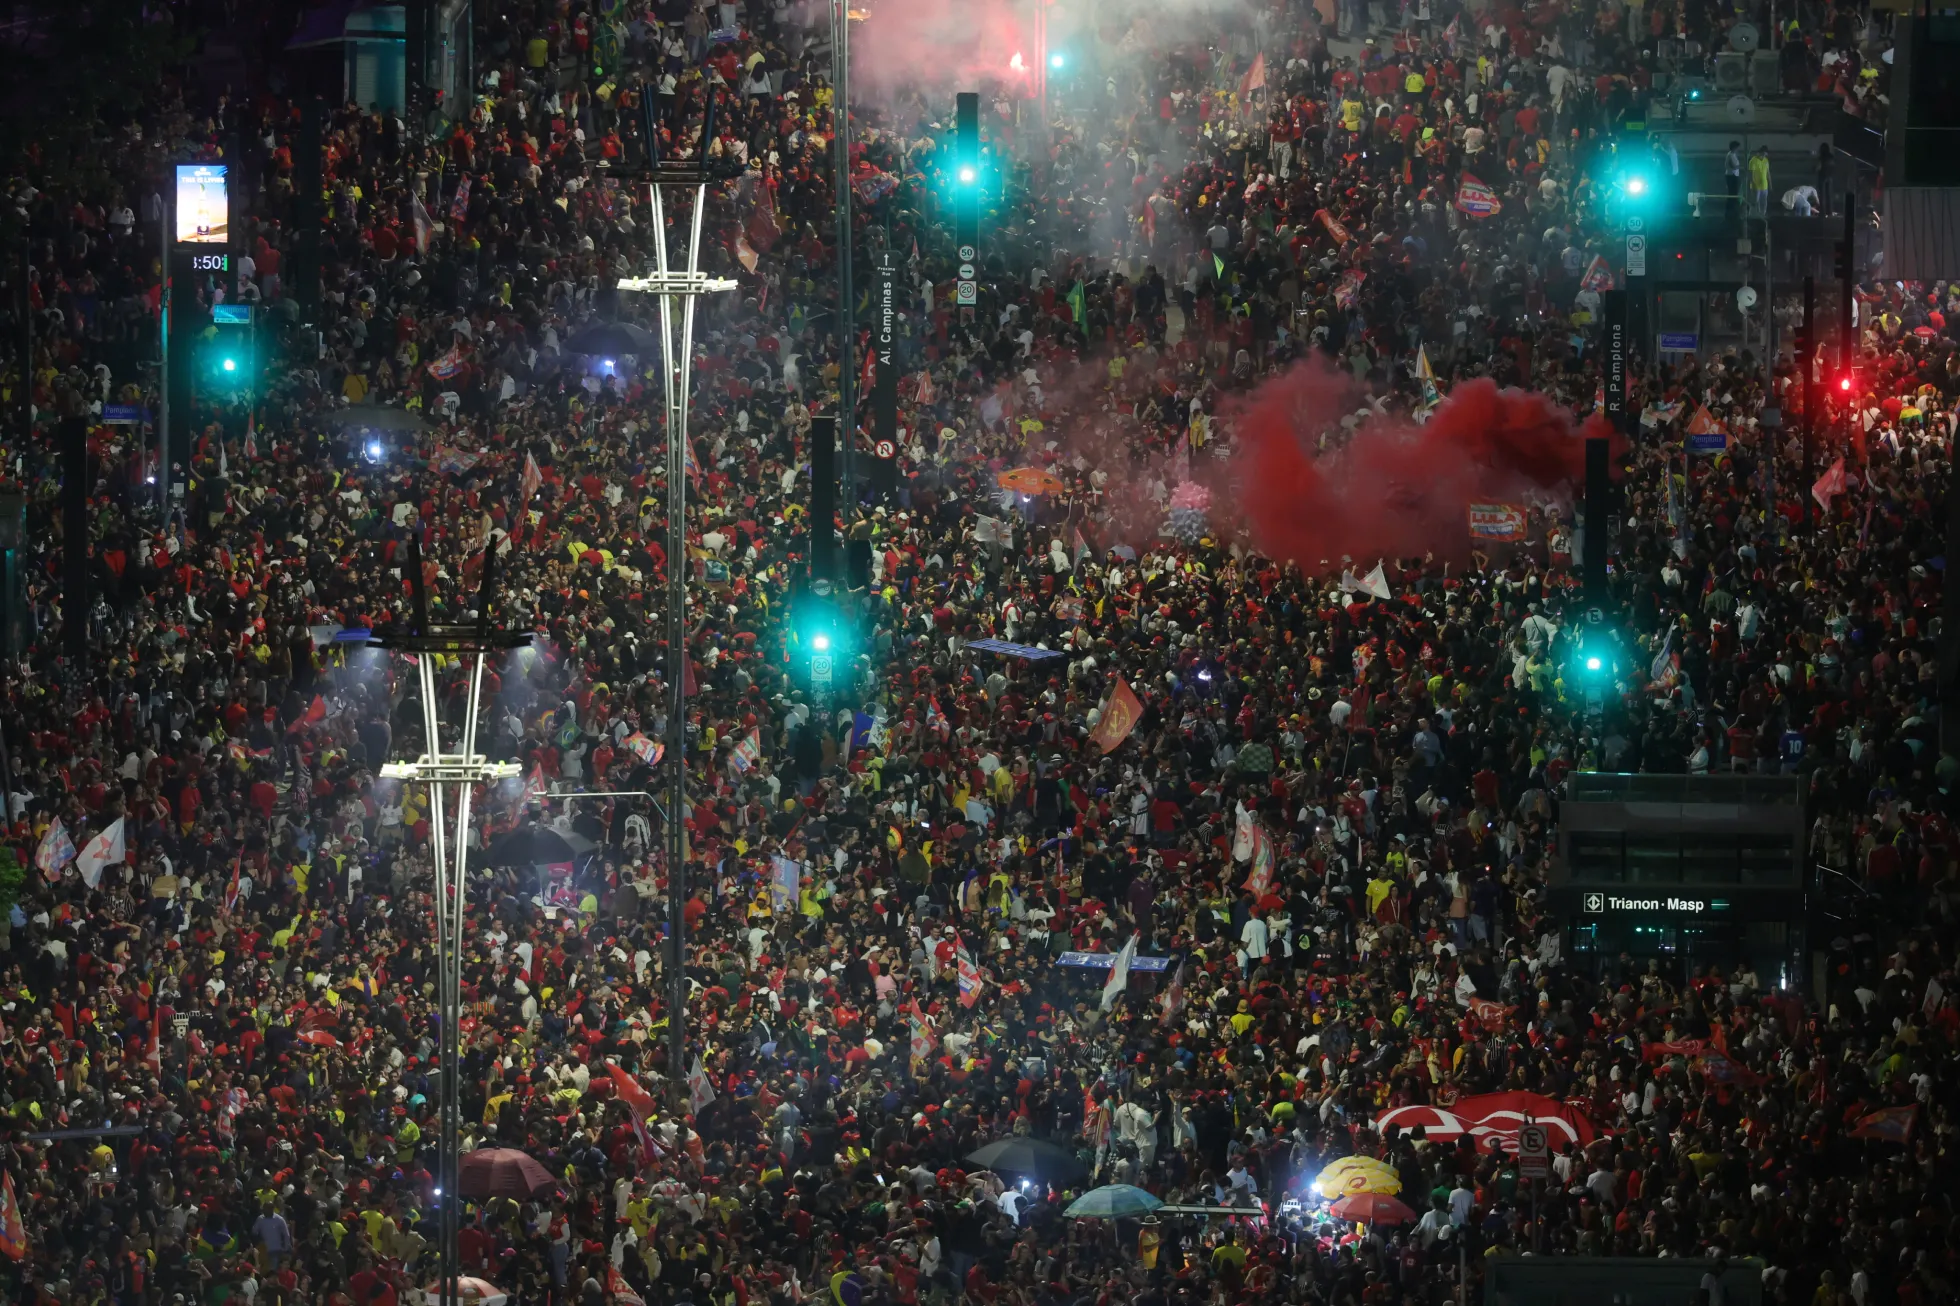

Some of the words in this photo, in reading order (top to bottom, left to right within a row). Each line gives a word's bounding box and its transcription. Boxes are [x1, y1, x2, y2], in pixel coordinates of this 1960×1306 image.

[1630, 219, 1641, 228] 50
[961, 248, 973, 257] 50
[961, 286, 972, 294] 20
[880, 281, 895, 344] Campinas
[880, 347, 891, 366] Al.
[1610, 324, 1624, 393] Pamplona
[1610, 397, 1621, 411] R.
[1472, 512, 1517, 525] LULA
[816, 661, 828, 669] 20
[1789, 740, 1801, 754] 10
[1608, 897, 1659, 910] Trianon
[1667, 898, 1705, 914] Masp
